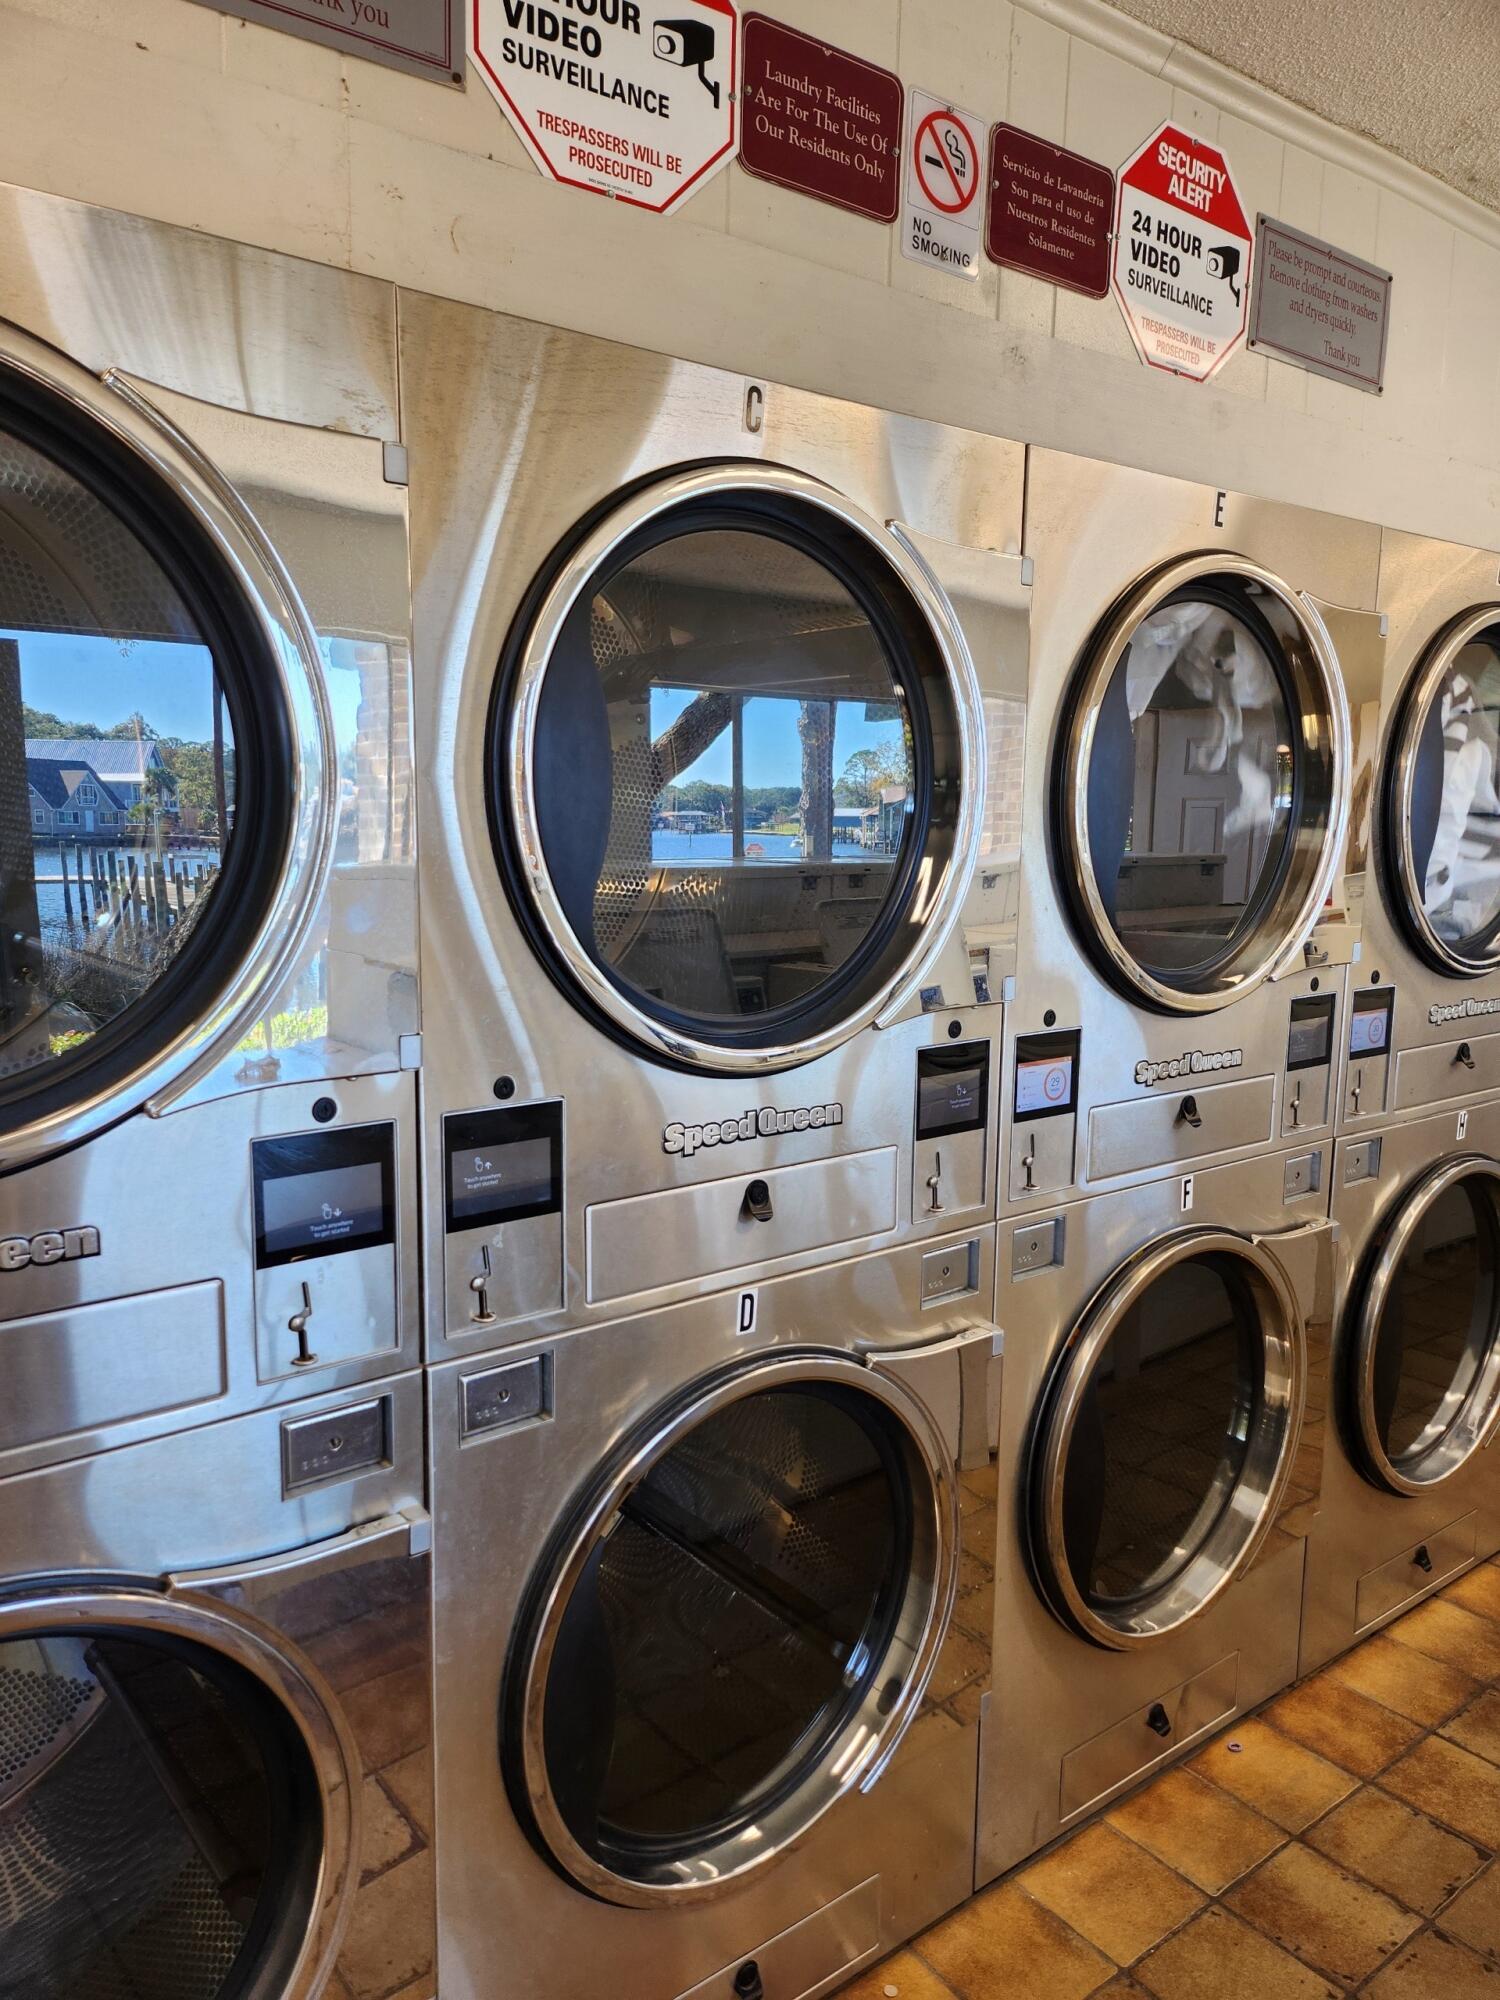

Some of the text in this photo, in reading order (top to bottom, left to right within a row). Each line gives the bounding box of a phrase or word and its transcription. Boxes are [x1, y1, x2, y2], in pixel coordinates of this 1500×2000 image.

[351, 5, 389, 28] you
[503, 0, 602, 58] VIDEO
[554, 0, 641, 34] OUR
[502, 37, 670, 119] SURVEILLANCE
[765, 60, 881, 124] Laundry Facilities
[755, 86, 889, 155] Are For The Use Of
[537, 110, 682, 175] TRESPASSERS WILL BE
[755, 115, 885, 183] Our Residents Only
[569, 146, 653, 187] PROSECUTED
[1002, 154, 1041, 181] Servicio
[1043, 171, 1055, 186] de
[1158, 141, 1226, 194] SECURITY
[1011, 181, 1095, 225] Son para el uso de
[1168, 174, 1213, 213] ALERT
[913, 217, 932, 235] NO
[1007, 201, 1096, 247] Nuestros Residentes
[1132, 210, 1202, 259] 24 HOUR
[912, 235, 970, 267] SMOKING
[1028, 231, 1075, 260] Solamente
[1131, 238, 1180, 278] VIDEO
[1268, 240, 1293, 264] Please
[1293, 250, 1303, 269] be
[1304, 260, 1332, 284] prompt
[1332, 272, 1346, 287] and
[1127, 268, 1213, 316] SURVEILLANCE
[1269, 264, 1378, 321] Remove clothing from washers
[1289, 299, 1304, 314] and
[1305, 302, 1328, 324] dryers
[1141, 316, 1217, 355] TRESPASSERS WILL BE
[1156, 340, 1200, 365] PROSECUTED
[1323, 340, 1360, 368] Thank you
[745, 385, 763, 433] C
[1214, 491, 1226, 528] E
[1428, 999, 1467, 1026] Speed
[1050, 1076, 1060, 1087] 29
[1134, 1048, 1242, 1087] Speed Queen
[663, 1102, 843, 1157] Speed Queen
[1183, 1179, 1191, 1208] F
[740, 1293, 755, 1332] D
